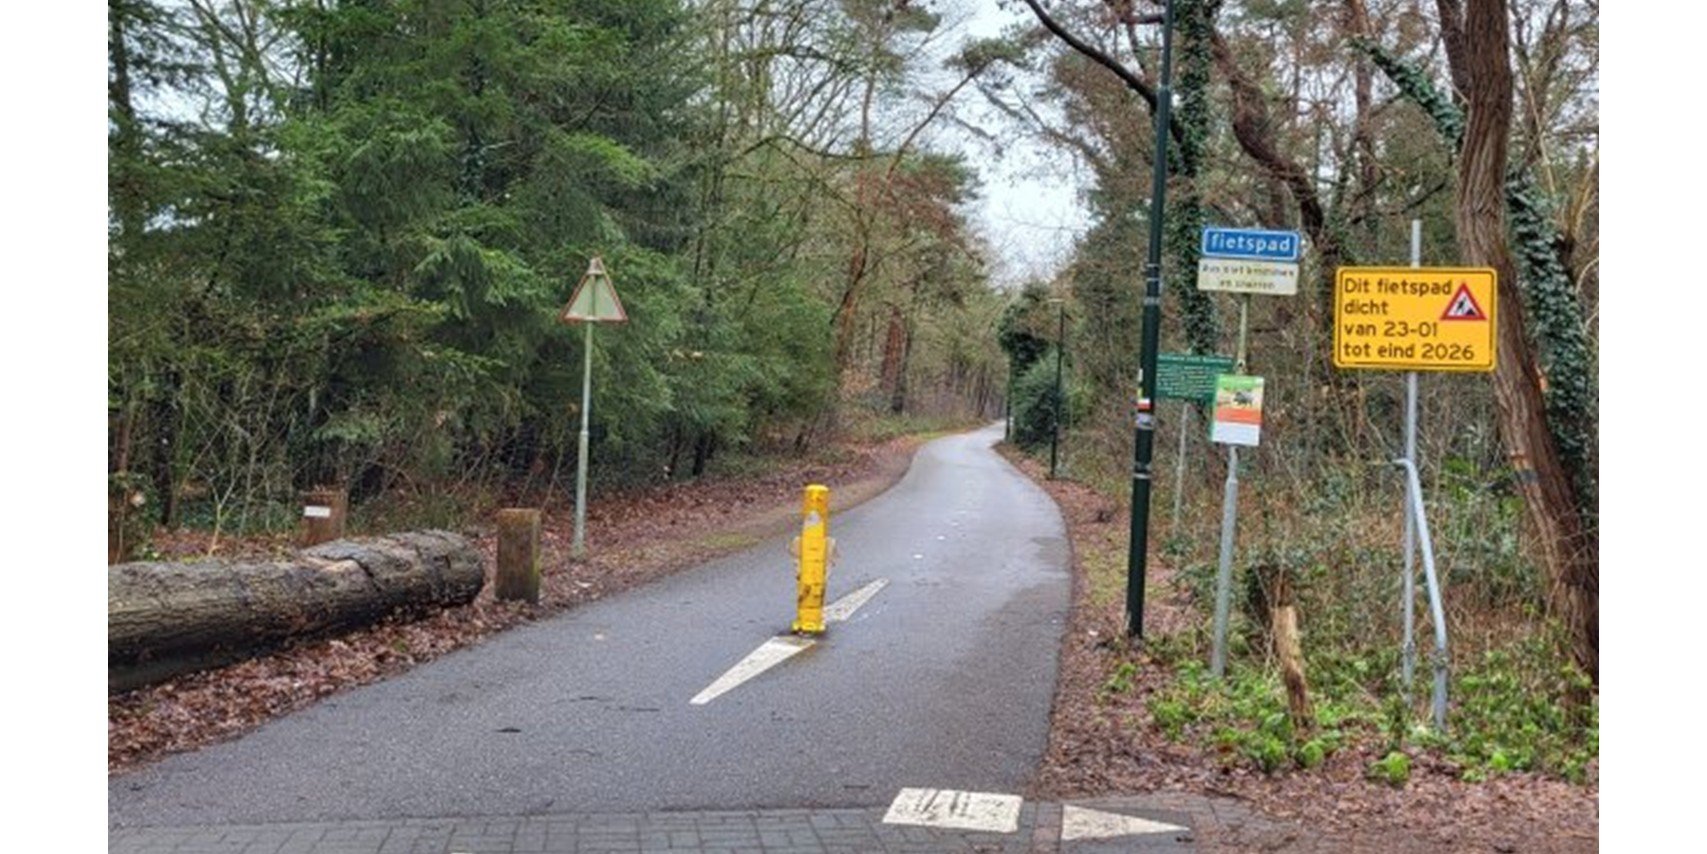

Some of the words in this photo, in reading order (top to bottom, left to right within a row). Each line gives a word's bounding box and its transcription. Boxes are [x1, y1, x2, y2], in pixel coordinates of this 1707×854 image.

[1211, 233, 1290, 253] fietspad
[1344, 278, 1370, 293] Dit
[1377, 278, 1452, 296] fietspad
[1344, 299, 1389, 315] dicht
[1344, 323, 1377, 336] van
[1383, 321, 1438, 337] 23-01
[1343, 343, 1371, 357] tot
[1377, 343, 1416, 358] eind
[1421, 343, 1475, 360] 2026
